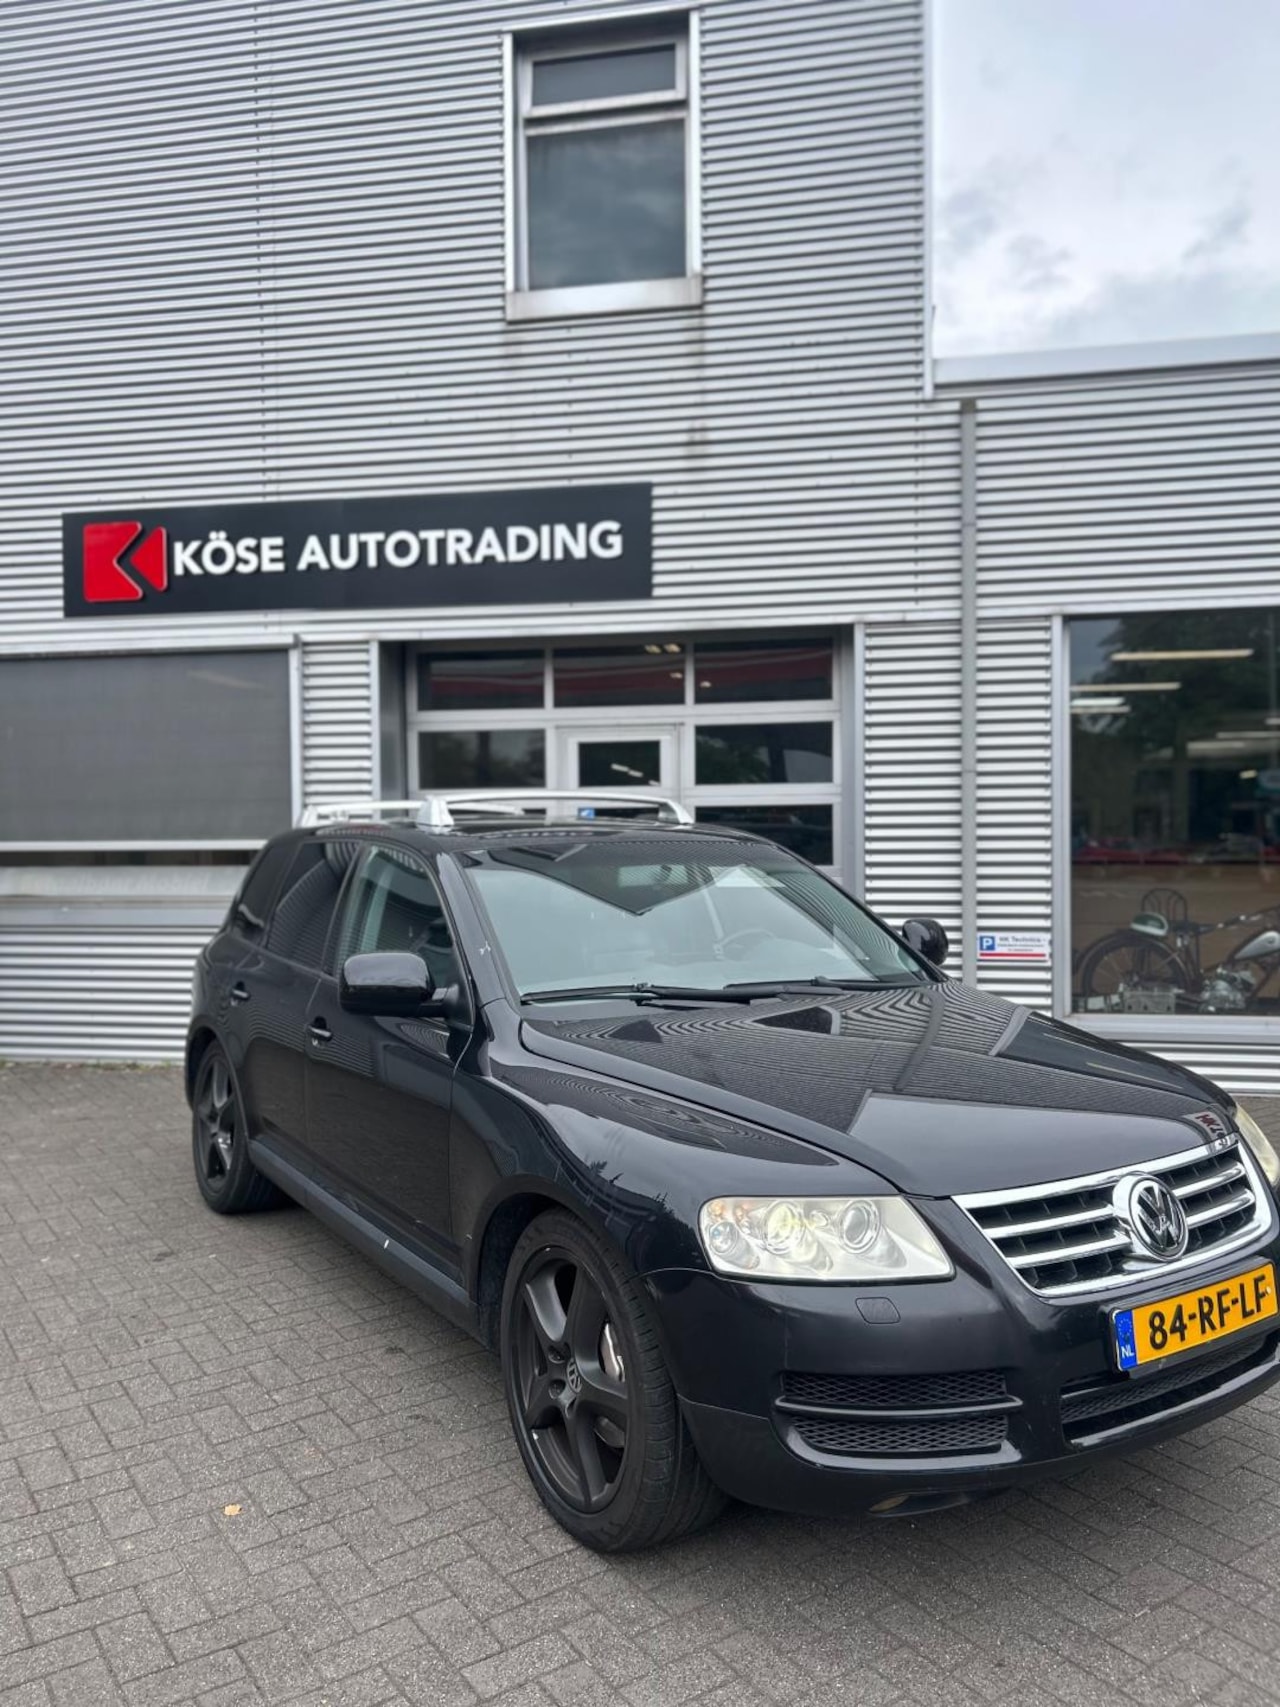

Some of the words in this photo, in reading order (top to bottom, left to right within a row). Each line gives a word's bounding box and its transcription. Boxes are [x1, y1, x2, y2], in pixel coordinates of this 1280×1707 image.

[174, 531, 285, 577] KÖSE
[297, 520, 623, 573] AUTOTRADING
[1149, 1275, 1267, 1350] 84-RF-LF
[1121, 1346, 1135, 1360] NL
